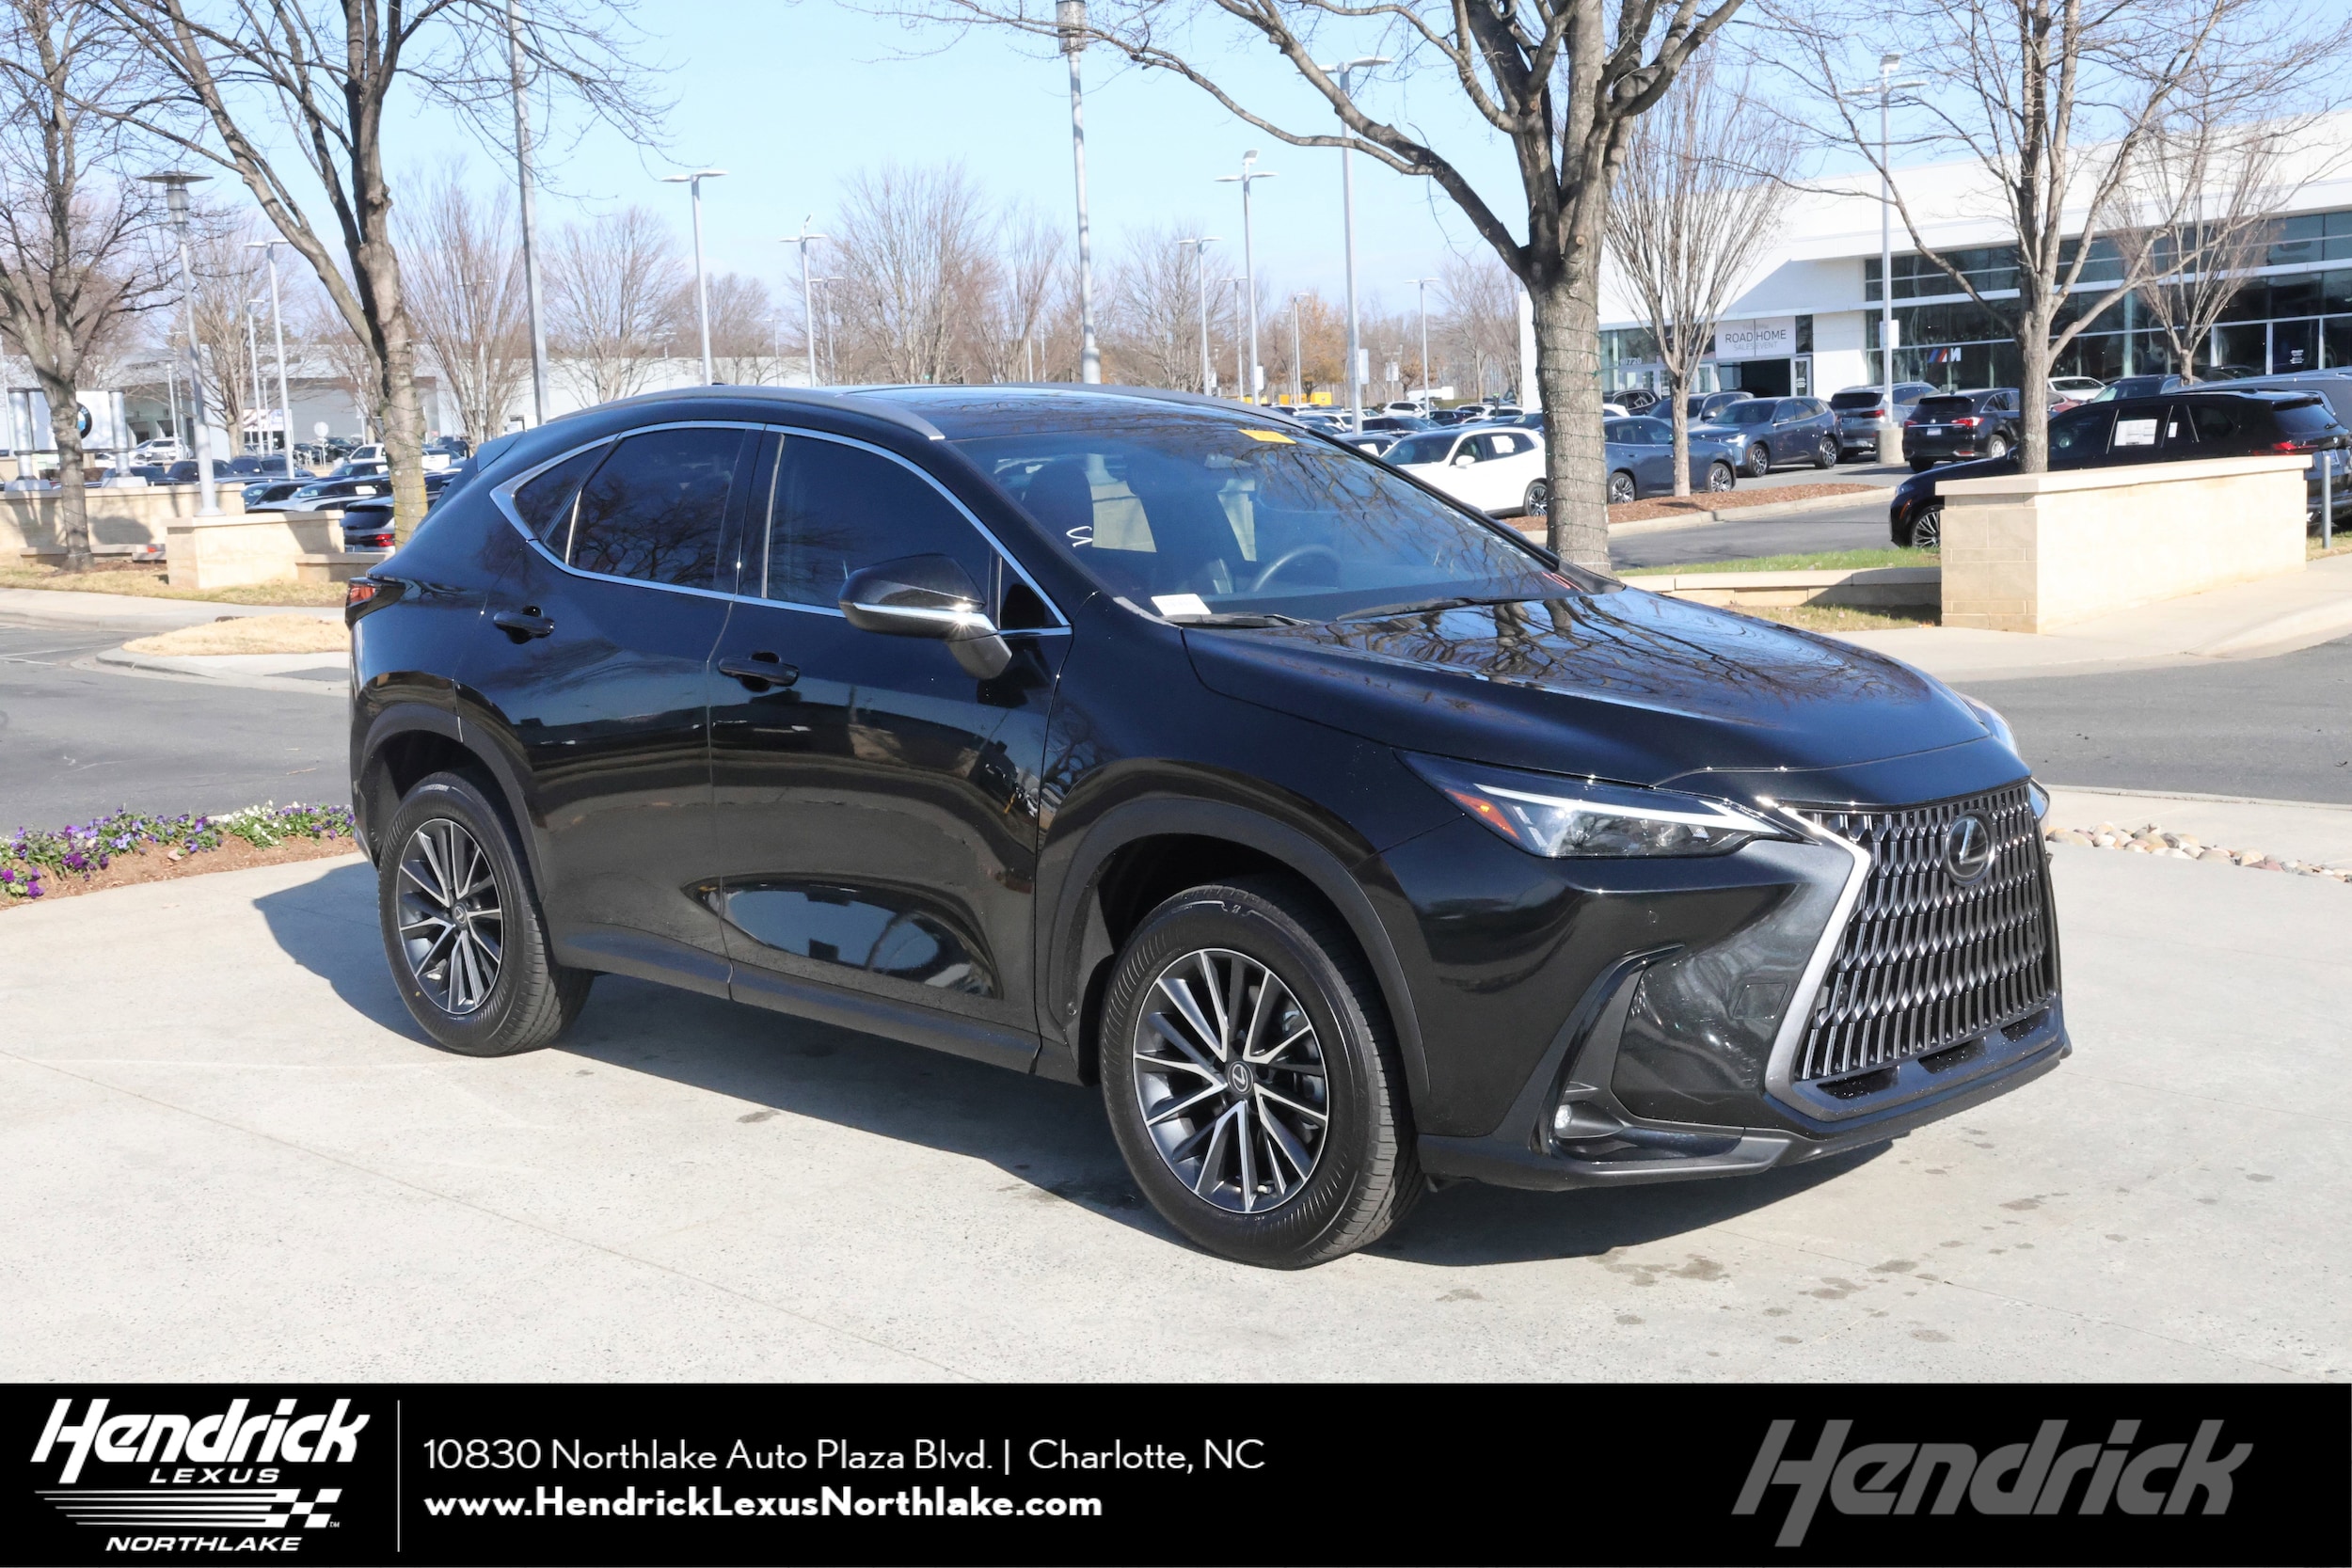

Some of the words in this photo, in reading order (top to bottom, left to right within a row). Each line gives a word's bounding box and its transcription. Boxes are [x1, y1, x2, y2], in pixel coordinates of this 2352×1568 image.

[1724, 332, 1754, 343] ROAD
[1756, 329, 1787, 341] HOME
[1733, 342, 1755, 351] SALES
[1756, 341, 1778, 349] EVENT
